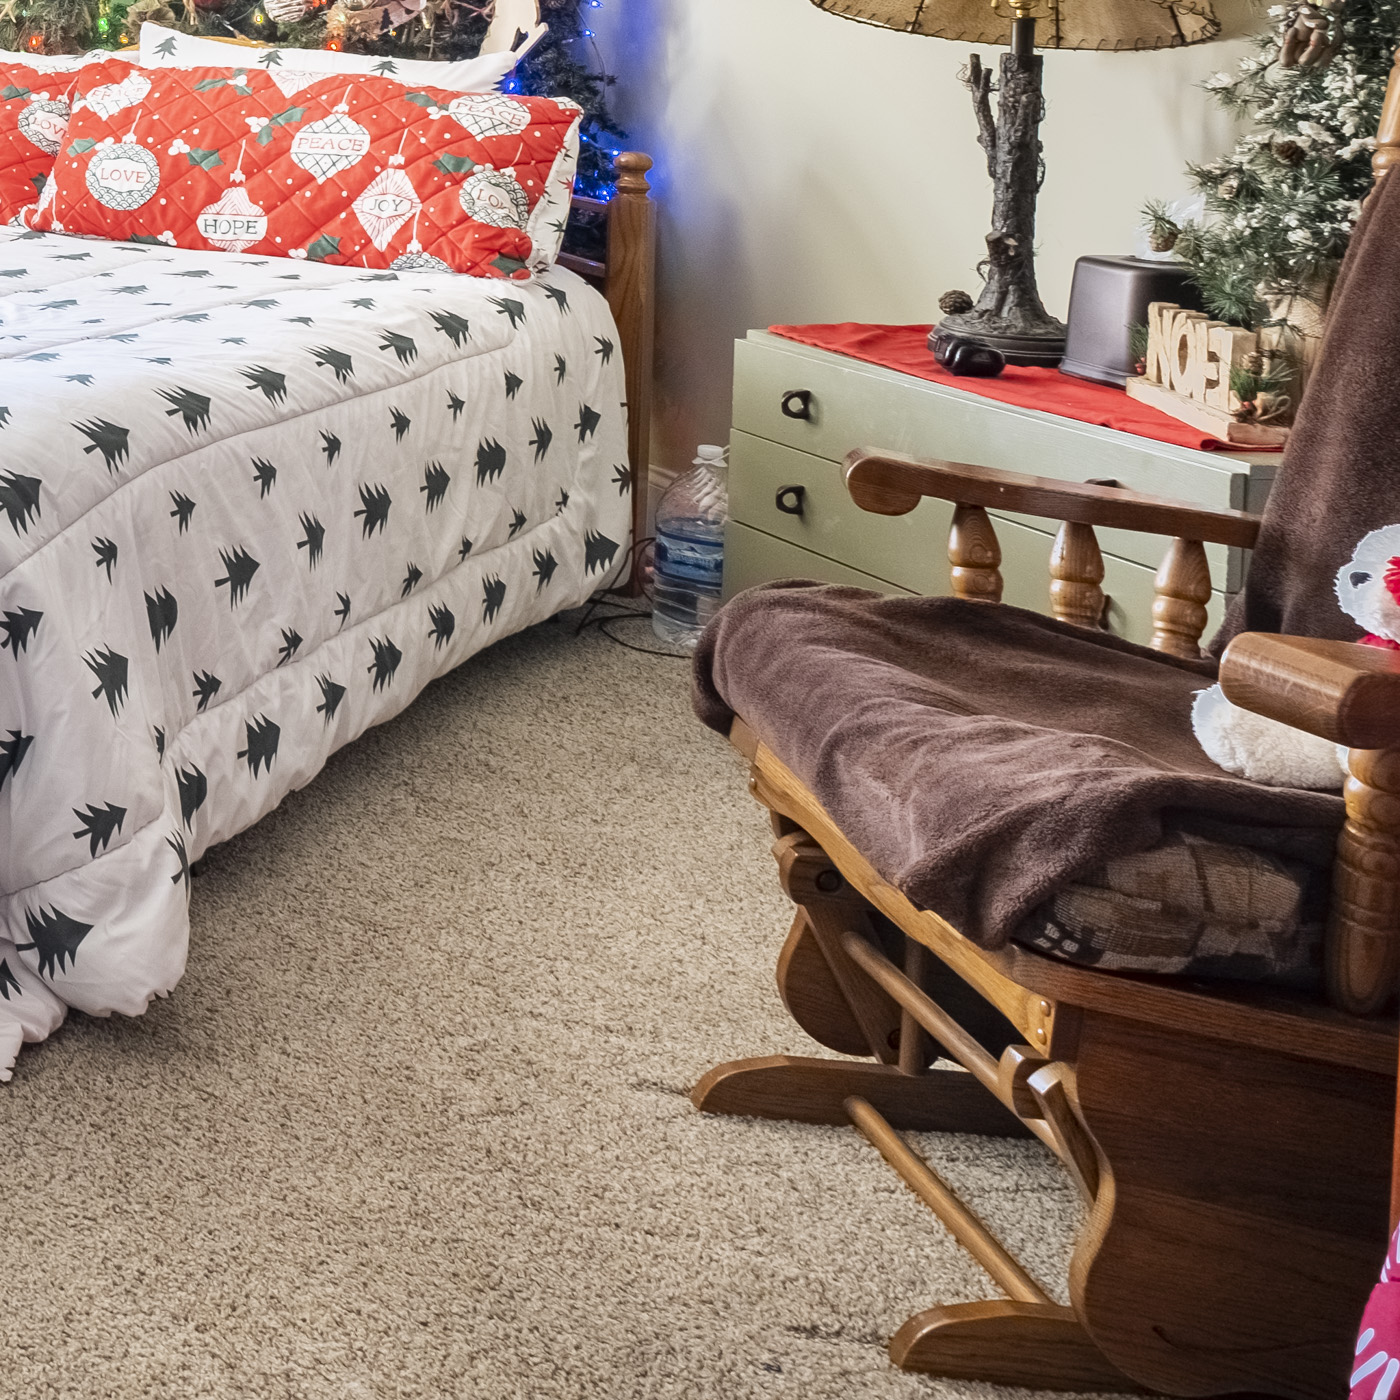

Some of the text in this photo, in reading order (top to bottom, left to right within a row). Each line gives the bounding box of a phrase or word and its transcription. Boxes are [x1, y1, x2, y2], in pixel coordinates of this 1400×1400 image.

[455, 101, 525, 127] PEACE
[297, 137, 365, 152] PEACE
[101, 167, 147, 184] LOVE
[369, 198, 404, 212] JOY
[203, 218, 259, 235] HOPE
[1146, 302, 1246, 415] NOEL
